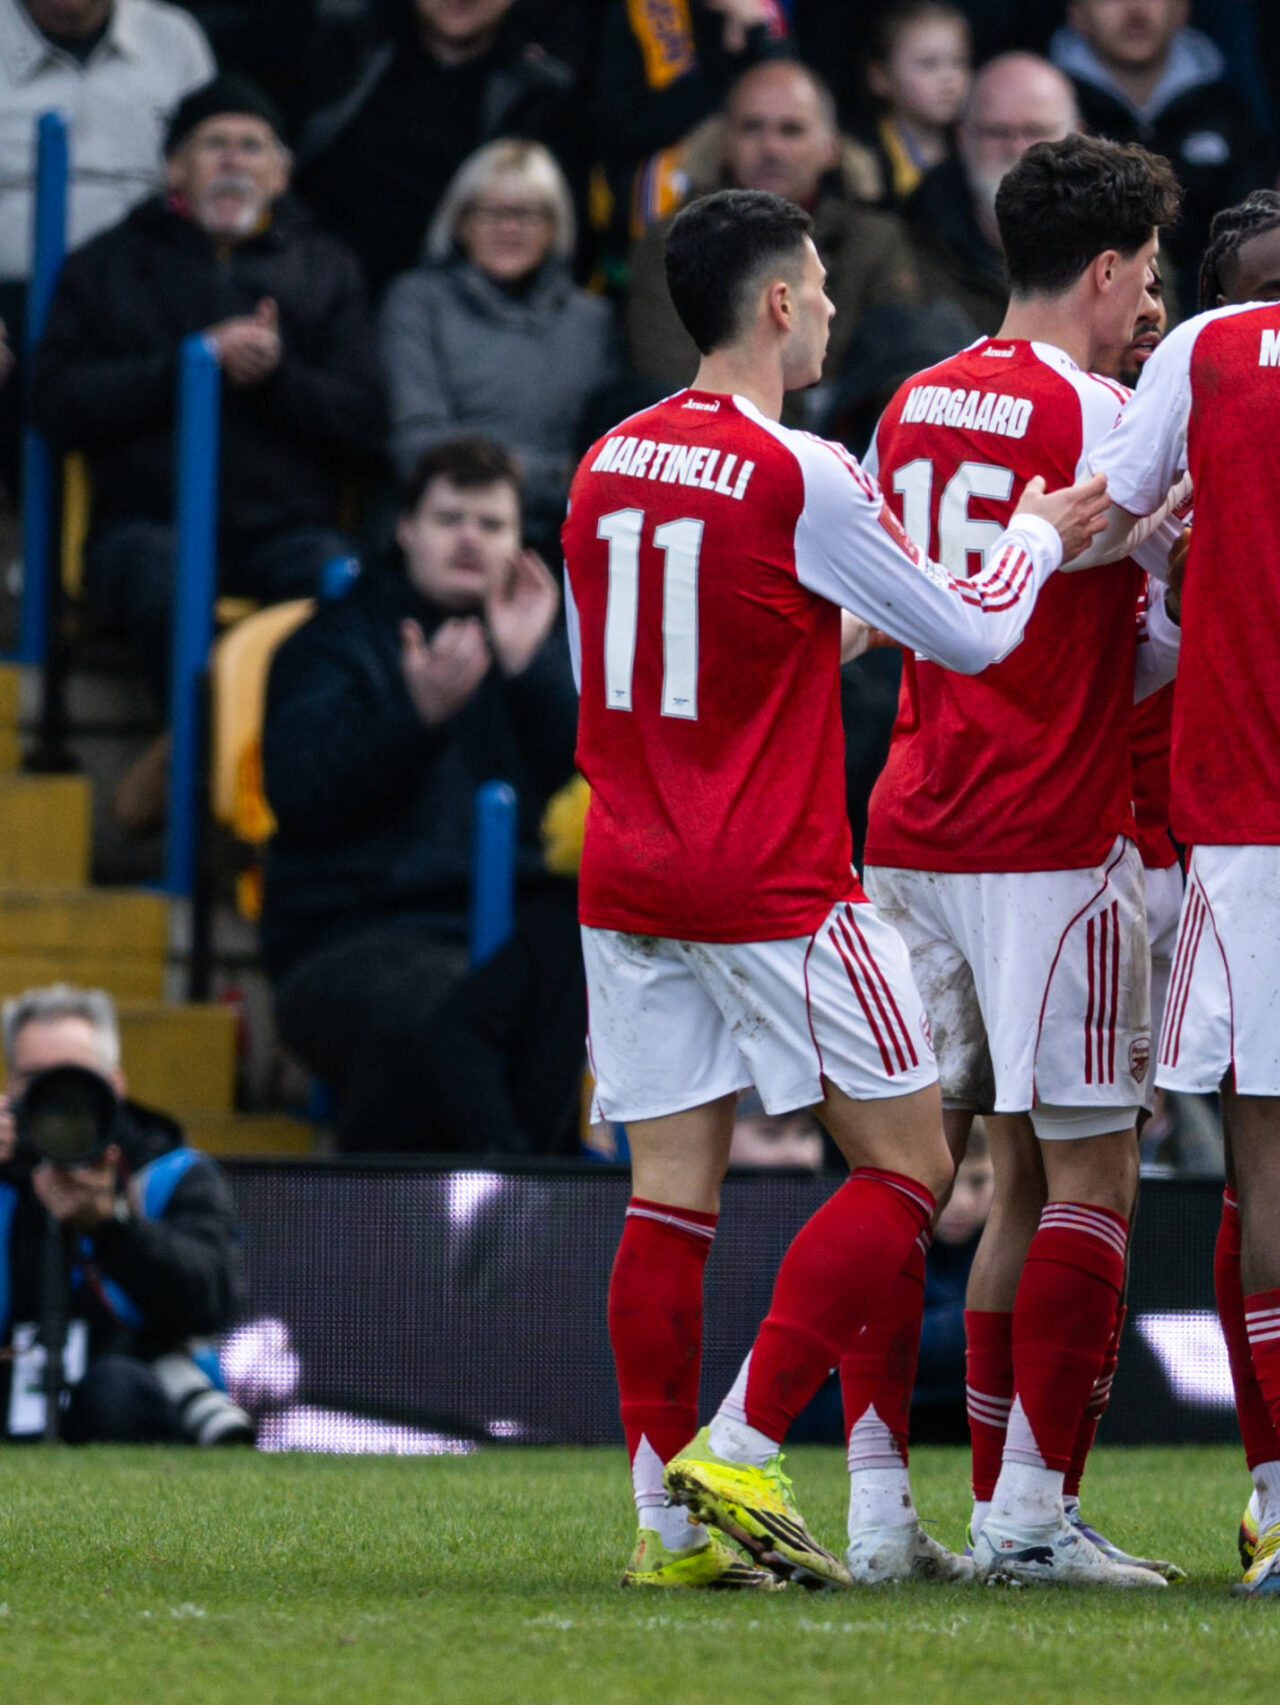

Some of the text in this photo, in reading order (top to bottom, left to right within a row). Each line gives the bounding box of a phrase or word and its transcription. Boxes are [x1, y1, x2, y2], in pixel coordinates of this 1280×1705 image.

[591, 436, 755, 500] MARTINELLI
[900, 385, 1033, 439] NØRGAARD
[597, 507, 705, 721] 11
[893, 458, 1024, 664] 16
